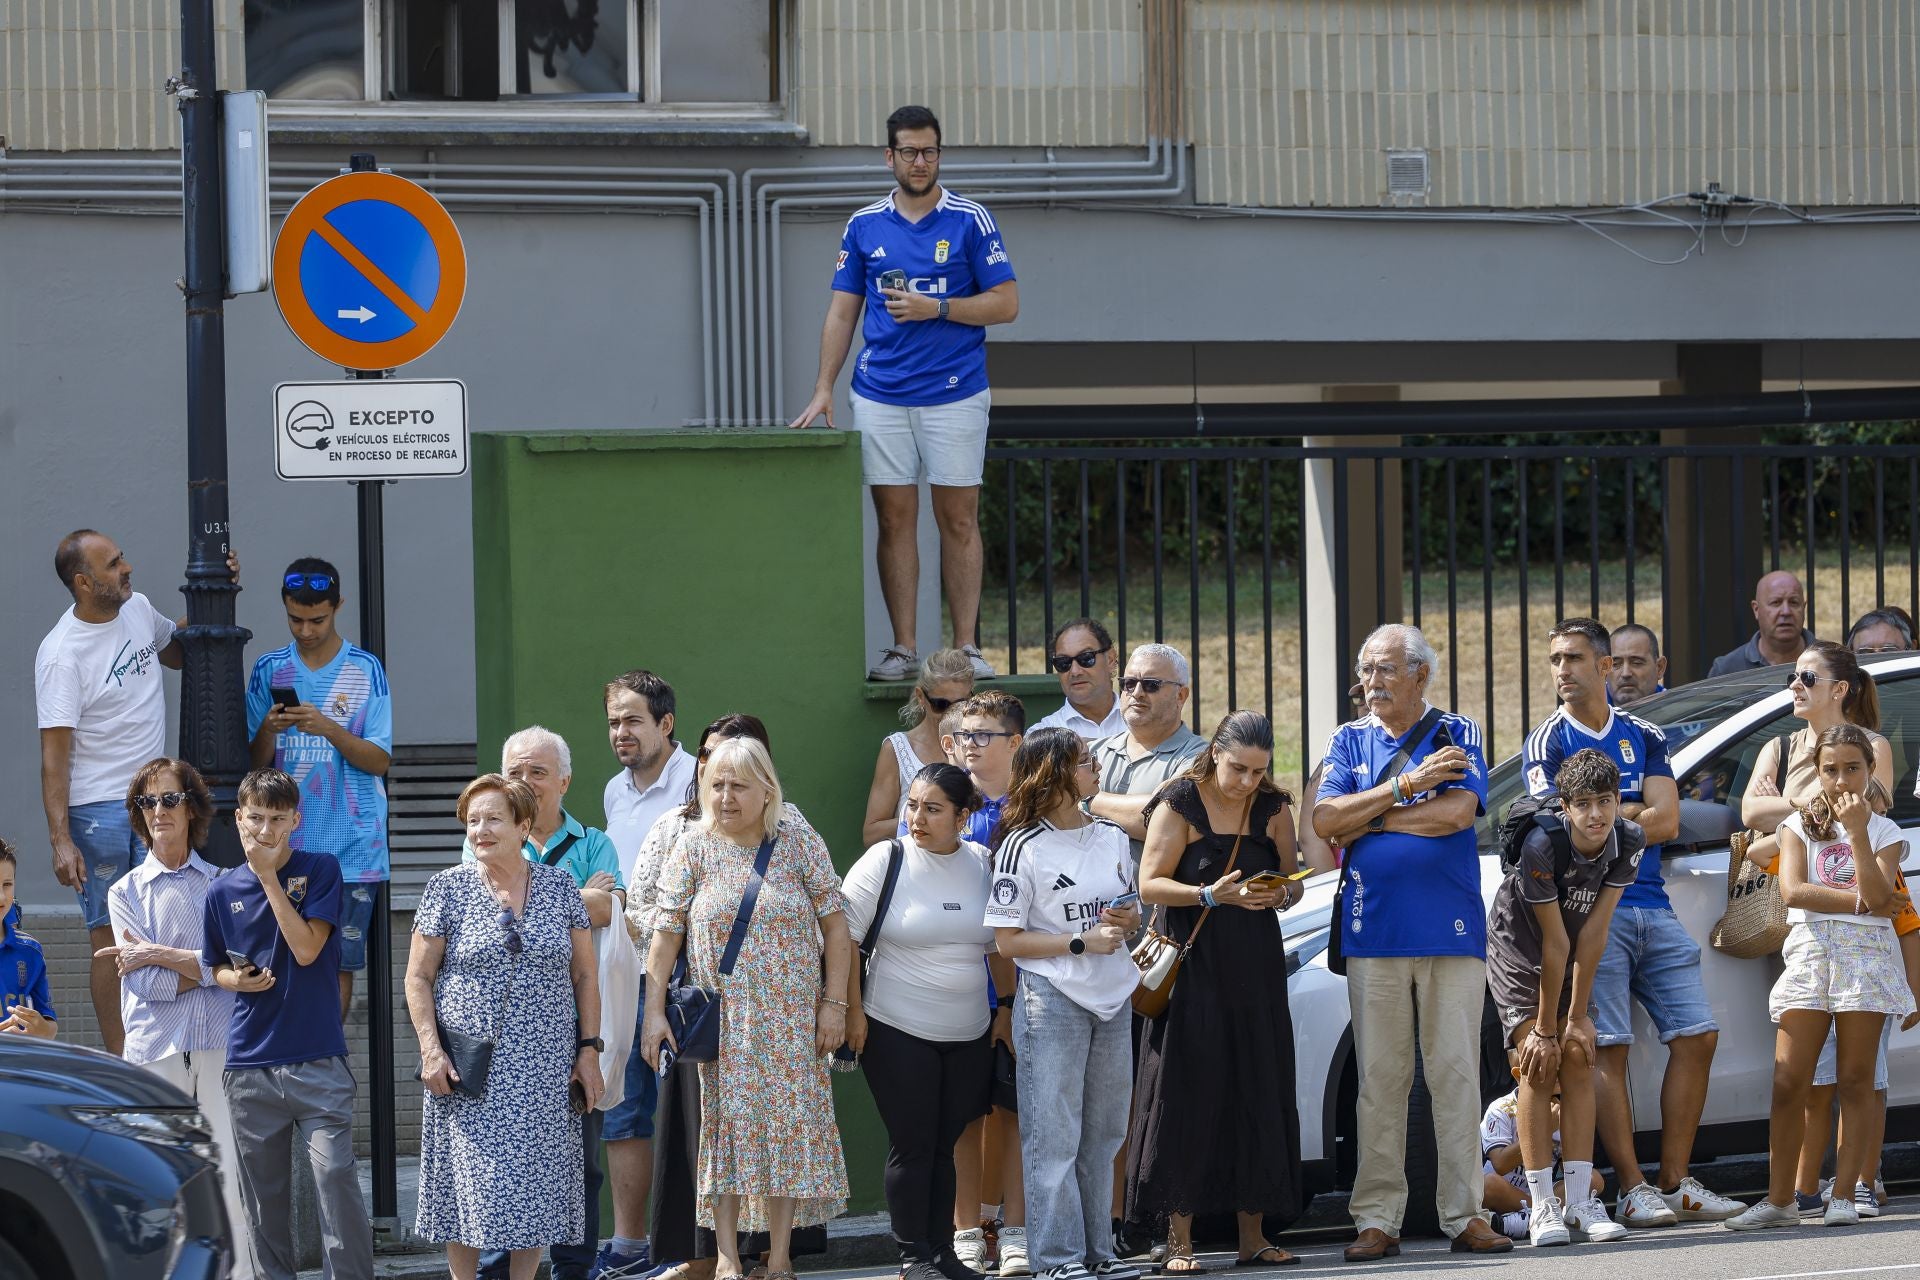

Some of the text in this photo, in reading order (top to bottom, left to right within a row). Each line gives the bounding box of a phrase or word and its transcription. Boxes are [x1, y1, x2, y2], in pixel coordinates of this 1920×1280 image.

[349, 409, 435, 426] EXCEPTO
[336, 432, 450, 445] VEHÍCULOS ELÉCTRICOS
[329, 449, 458, 461] EN PROCESO DE RECARGA
[283, 749, 333, 762] FLY BETTER
[1001, 890, 1009, 898] 15
[1563, 900, 1578, 911] FLY
